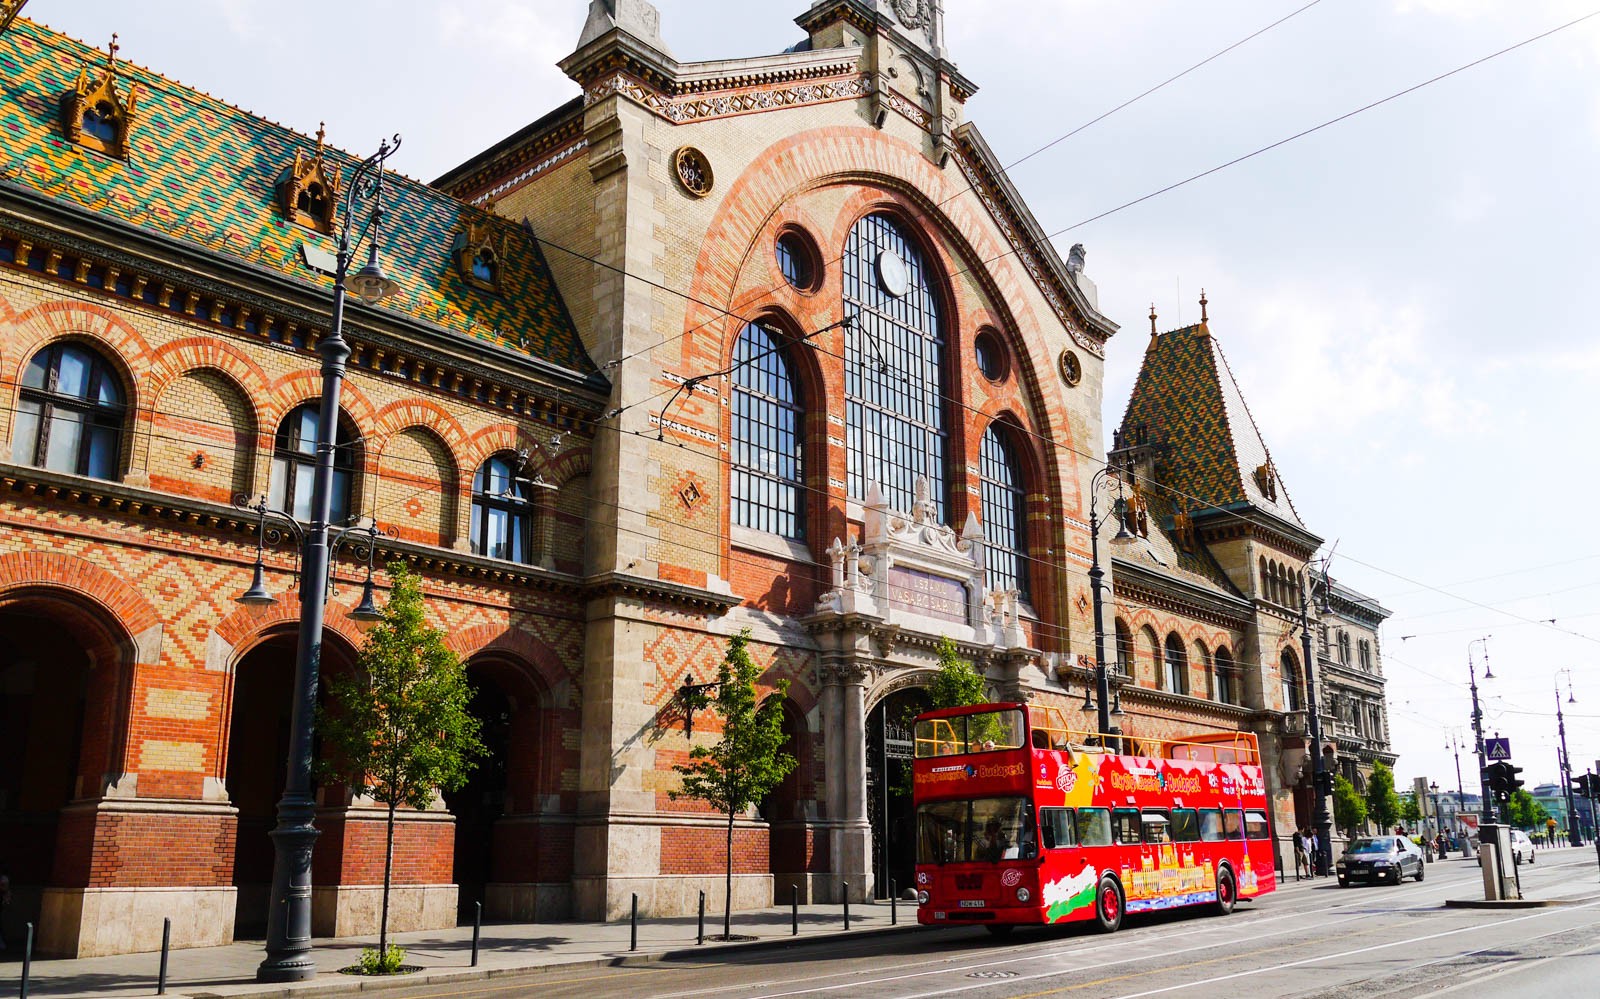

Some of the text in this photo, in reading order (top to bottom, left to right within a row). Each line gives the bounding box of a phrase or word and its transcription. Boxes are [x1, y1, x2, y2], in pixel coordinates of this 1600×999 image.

[979, 762, 1025, 778] Budapest
[1167, 772, 1202, 796] Budapest
[917, 872, 928, 885] 48
